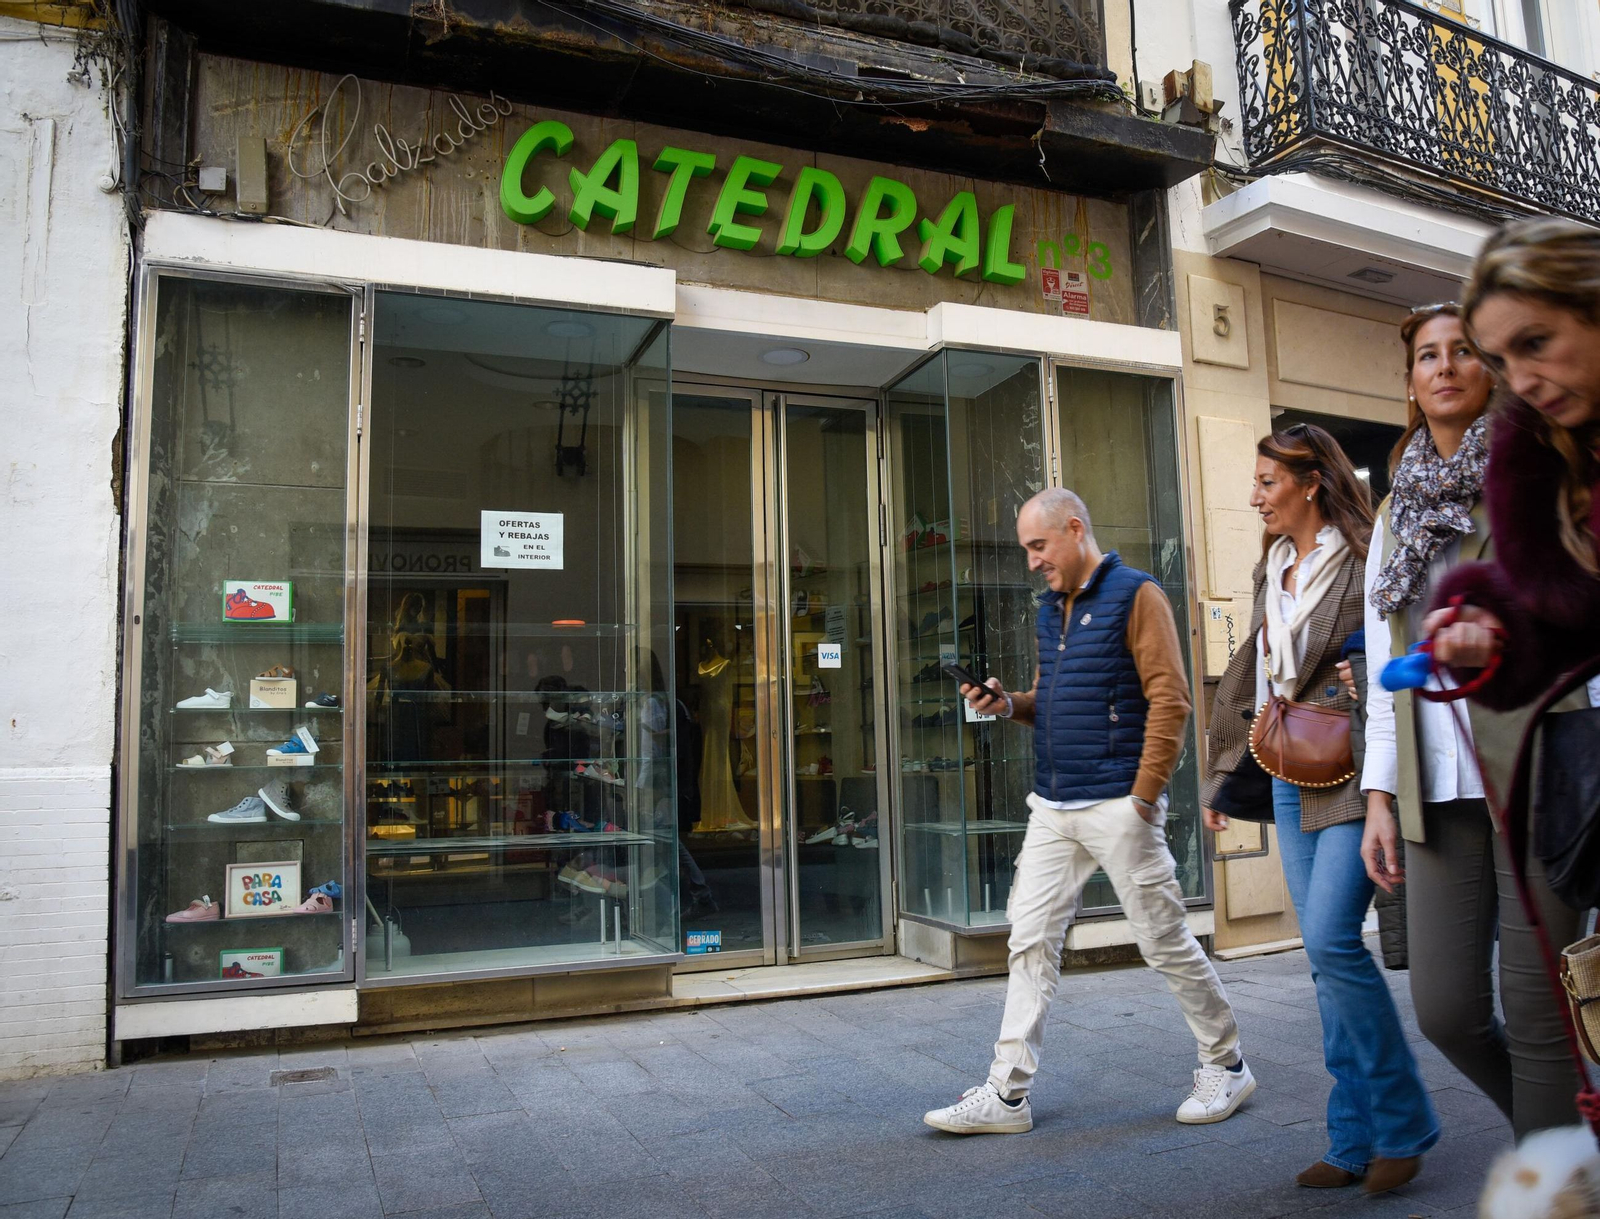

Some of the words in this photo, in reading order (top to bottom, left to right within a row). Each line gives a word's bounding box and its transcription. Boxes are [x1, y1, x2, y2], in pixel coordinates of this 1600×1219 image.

[288, 73, 514, 216] Calzados
[499, 119, 1027, 286] CATEDRAL
[1063, 291, 1087, 301] Alarma
[1212, 303, 1231, 337] 5
[499, 520, 541, 529] OFERTAS
[508, 532, 550, 541] REBAJAS
[821, 652, 840, 660] VISA
[242, 873, 282, 890] PARA
[243, 890, 283, 906] CASA
[689, 935, 719, 944] CERRADO
